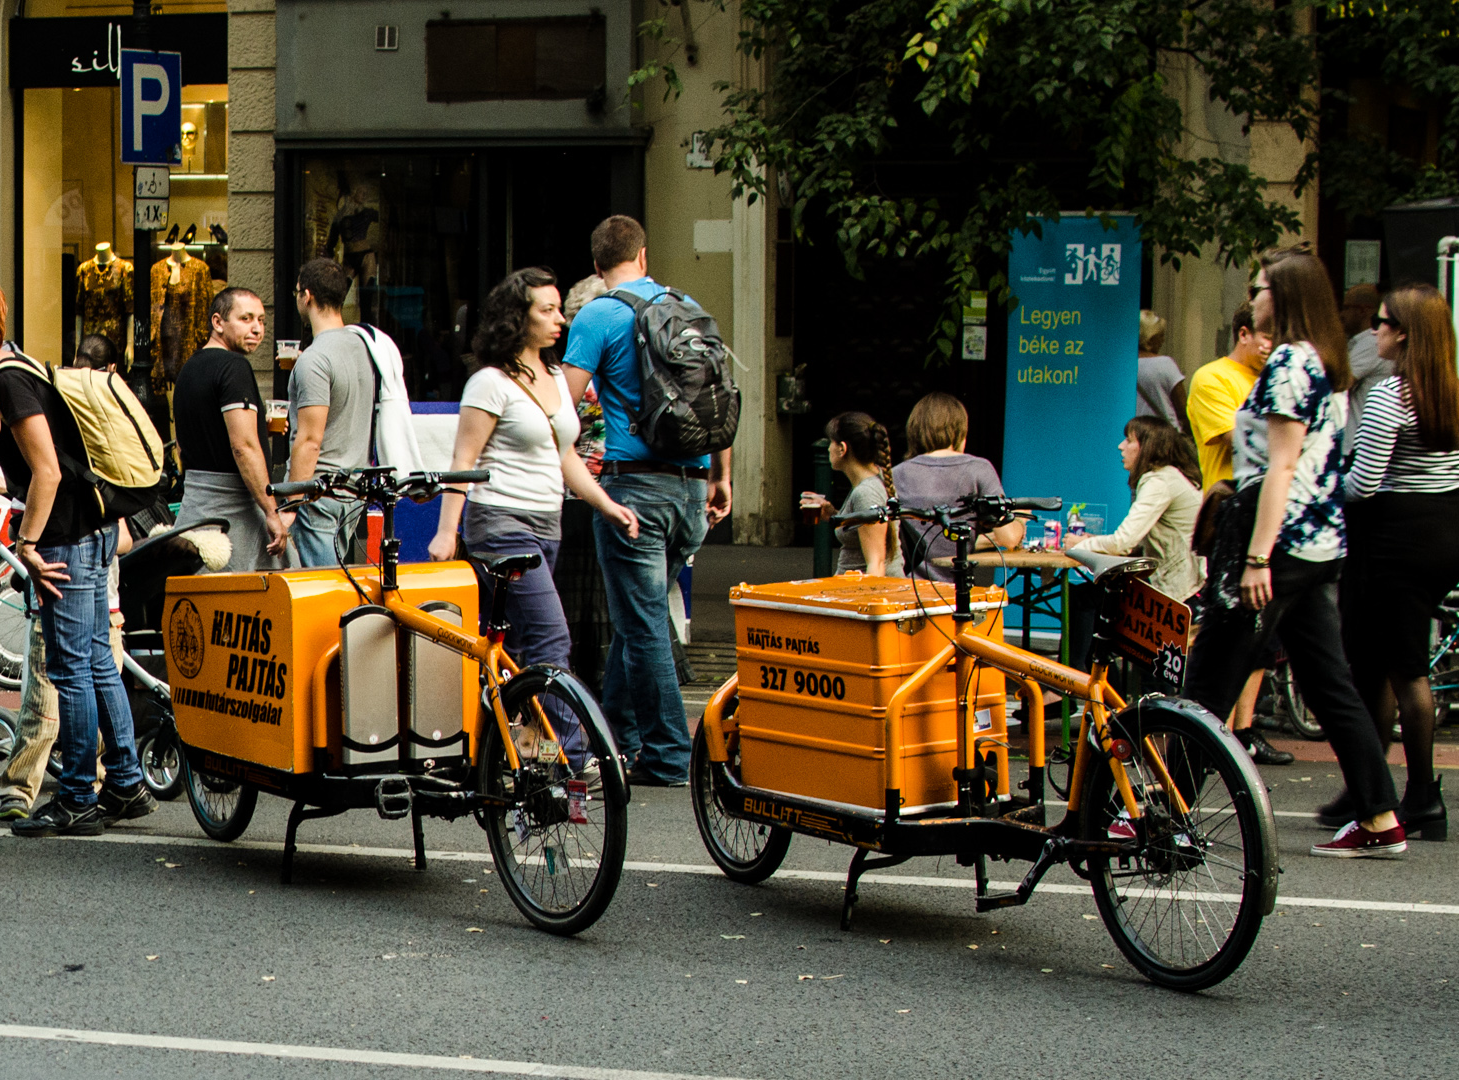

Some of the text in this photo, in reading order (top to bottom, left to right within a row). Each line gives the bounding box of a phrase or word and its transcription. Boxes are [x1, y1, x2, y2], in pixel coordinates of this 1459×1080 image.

[133, 63, 170, 151] P
[1020, 305, 1081, 330] Legyen
[1019, 335, 1084, 355] béke az
[1017, 365, 1079, 385] utakon!
[210, 610, 272, 655] HAJTÁS
[747, 631, 820, 655] HAJTÁS PAJTÁS
[1163, 650, 1181, 673] 20
[226, 654, 287, 700] PAJTÁS
[760, 665, 845, 700] 327 9000
[1163, 667, 1179, 684] éve
[204, 690, 282, 726] futárszolgálat
[744, 797, 802, 824] BULLITT
